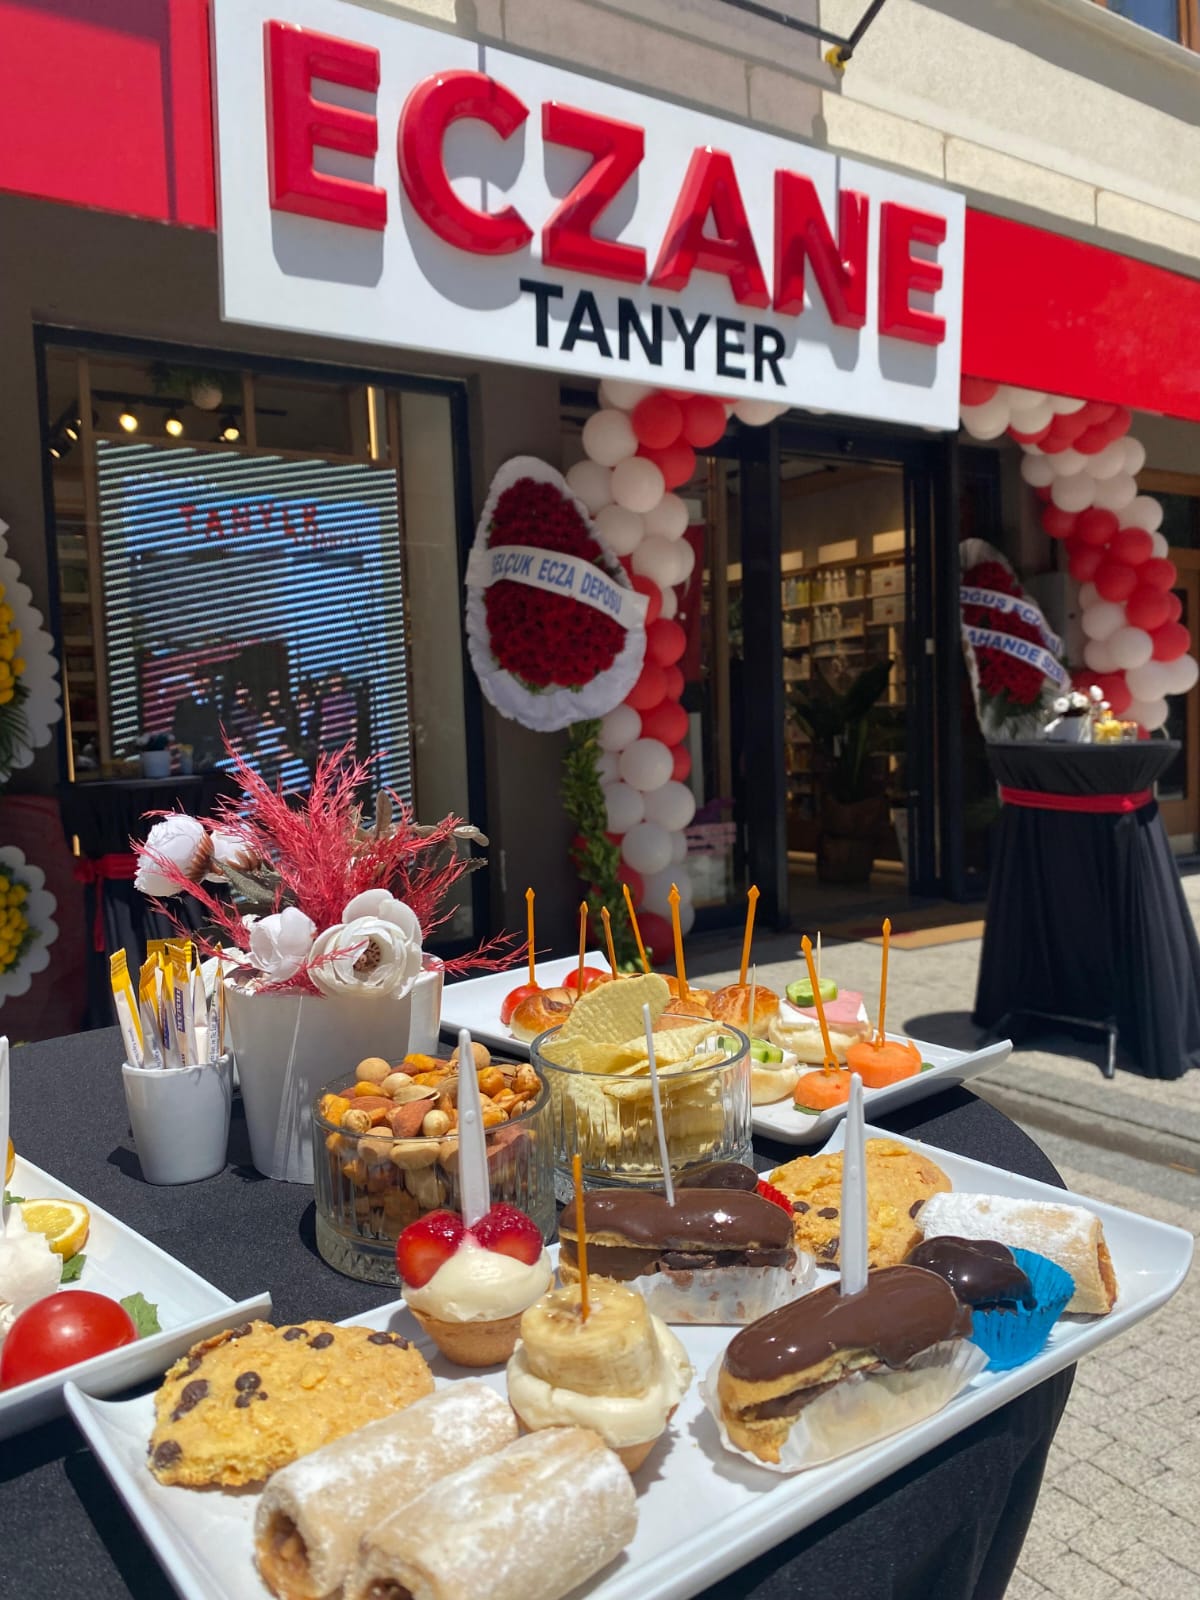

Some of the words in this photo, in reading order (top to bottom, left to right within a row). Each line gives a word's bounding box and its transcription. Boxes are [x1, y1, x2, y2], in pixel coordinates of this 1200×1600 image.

[263, 20, 947, 346] ECZANE
[519, 277, 788, 387] TANYER
[537, 558, 576, 590] ECZA
